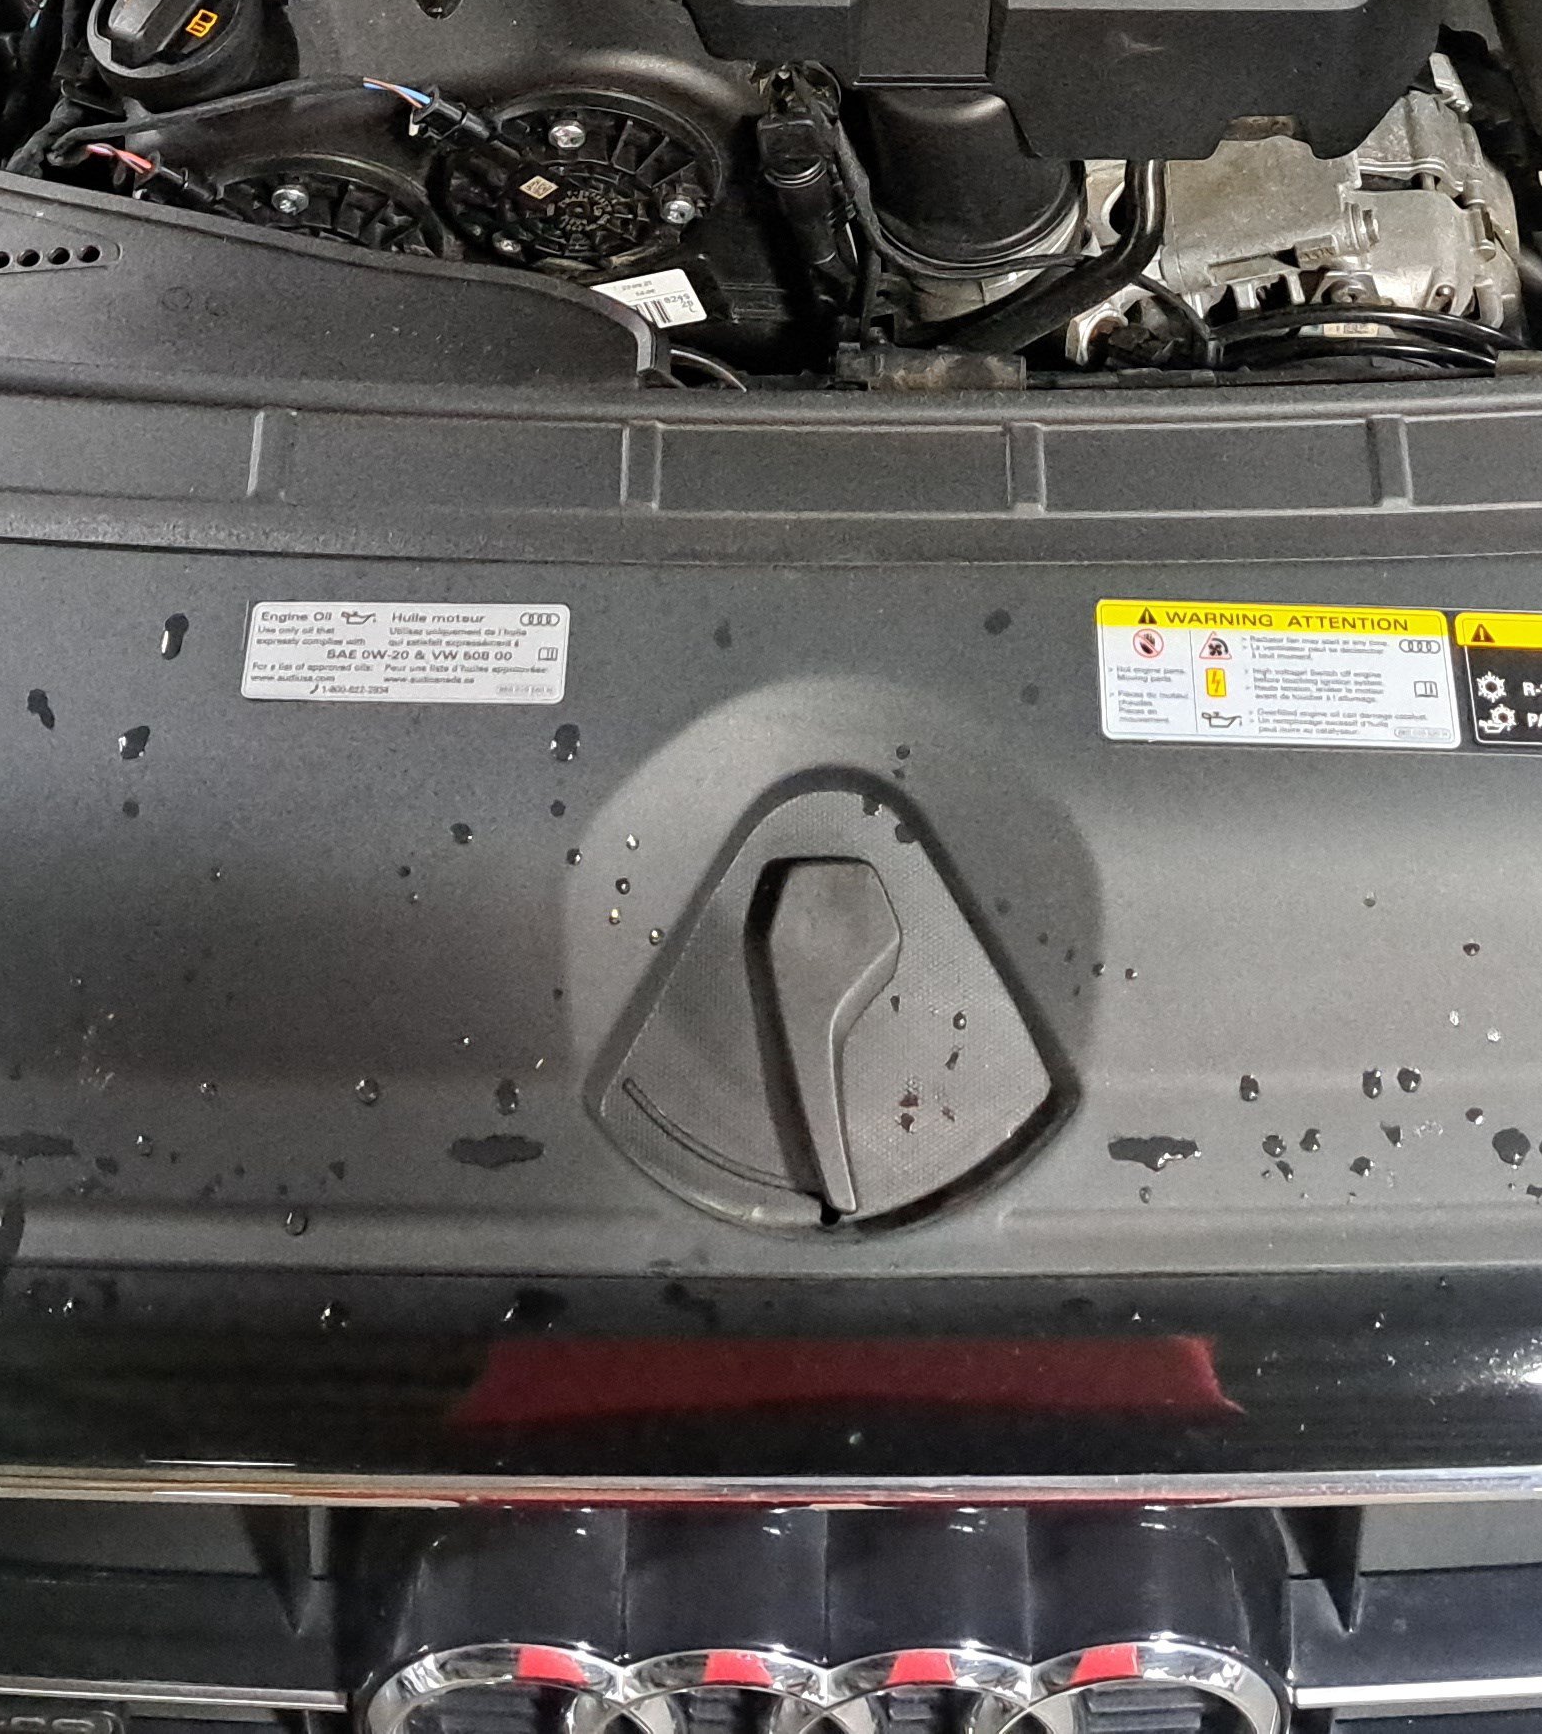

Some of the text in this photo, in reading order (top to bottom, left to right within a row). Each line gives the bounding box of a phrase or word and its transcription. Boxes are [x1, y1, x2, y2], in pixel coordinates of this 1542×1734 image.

[261, 611, 332, 623] Engine Oil
[392, 612, 484, 623] Huile moteur
[1165, 611, 1409, 631] WARNING ATTENTION
[327, 649, 357, 659] SAE
[362, 649, 409, 660] 0W-20
[414, 650, 425, 660] &
[431, 650, 459, 660] VW
[494, 651, 513, 661] 00
